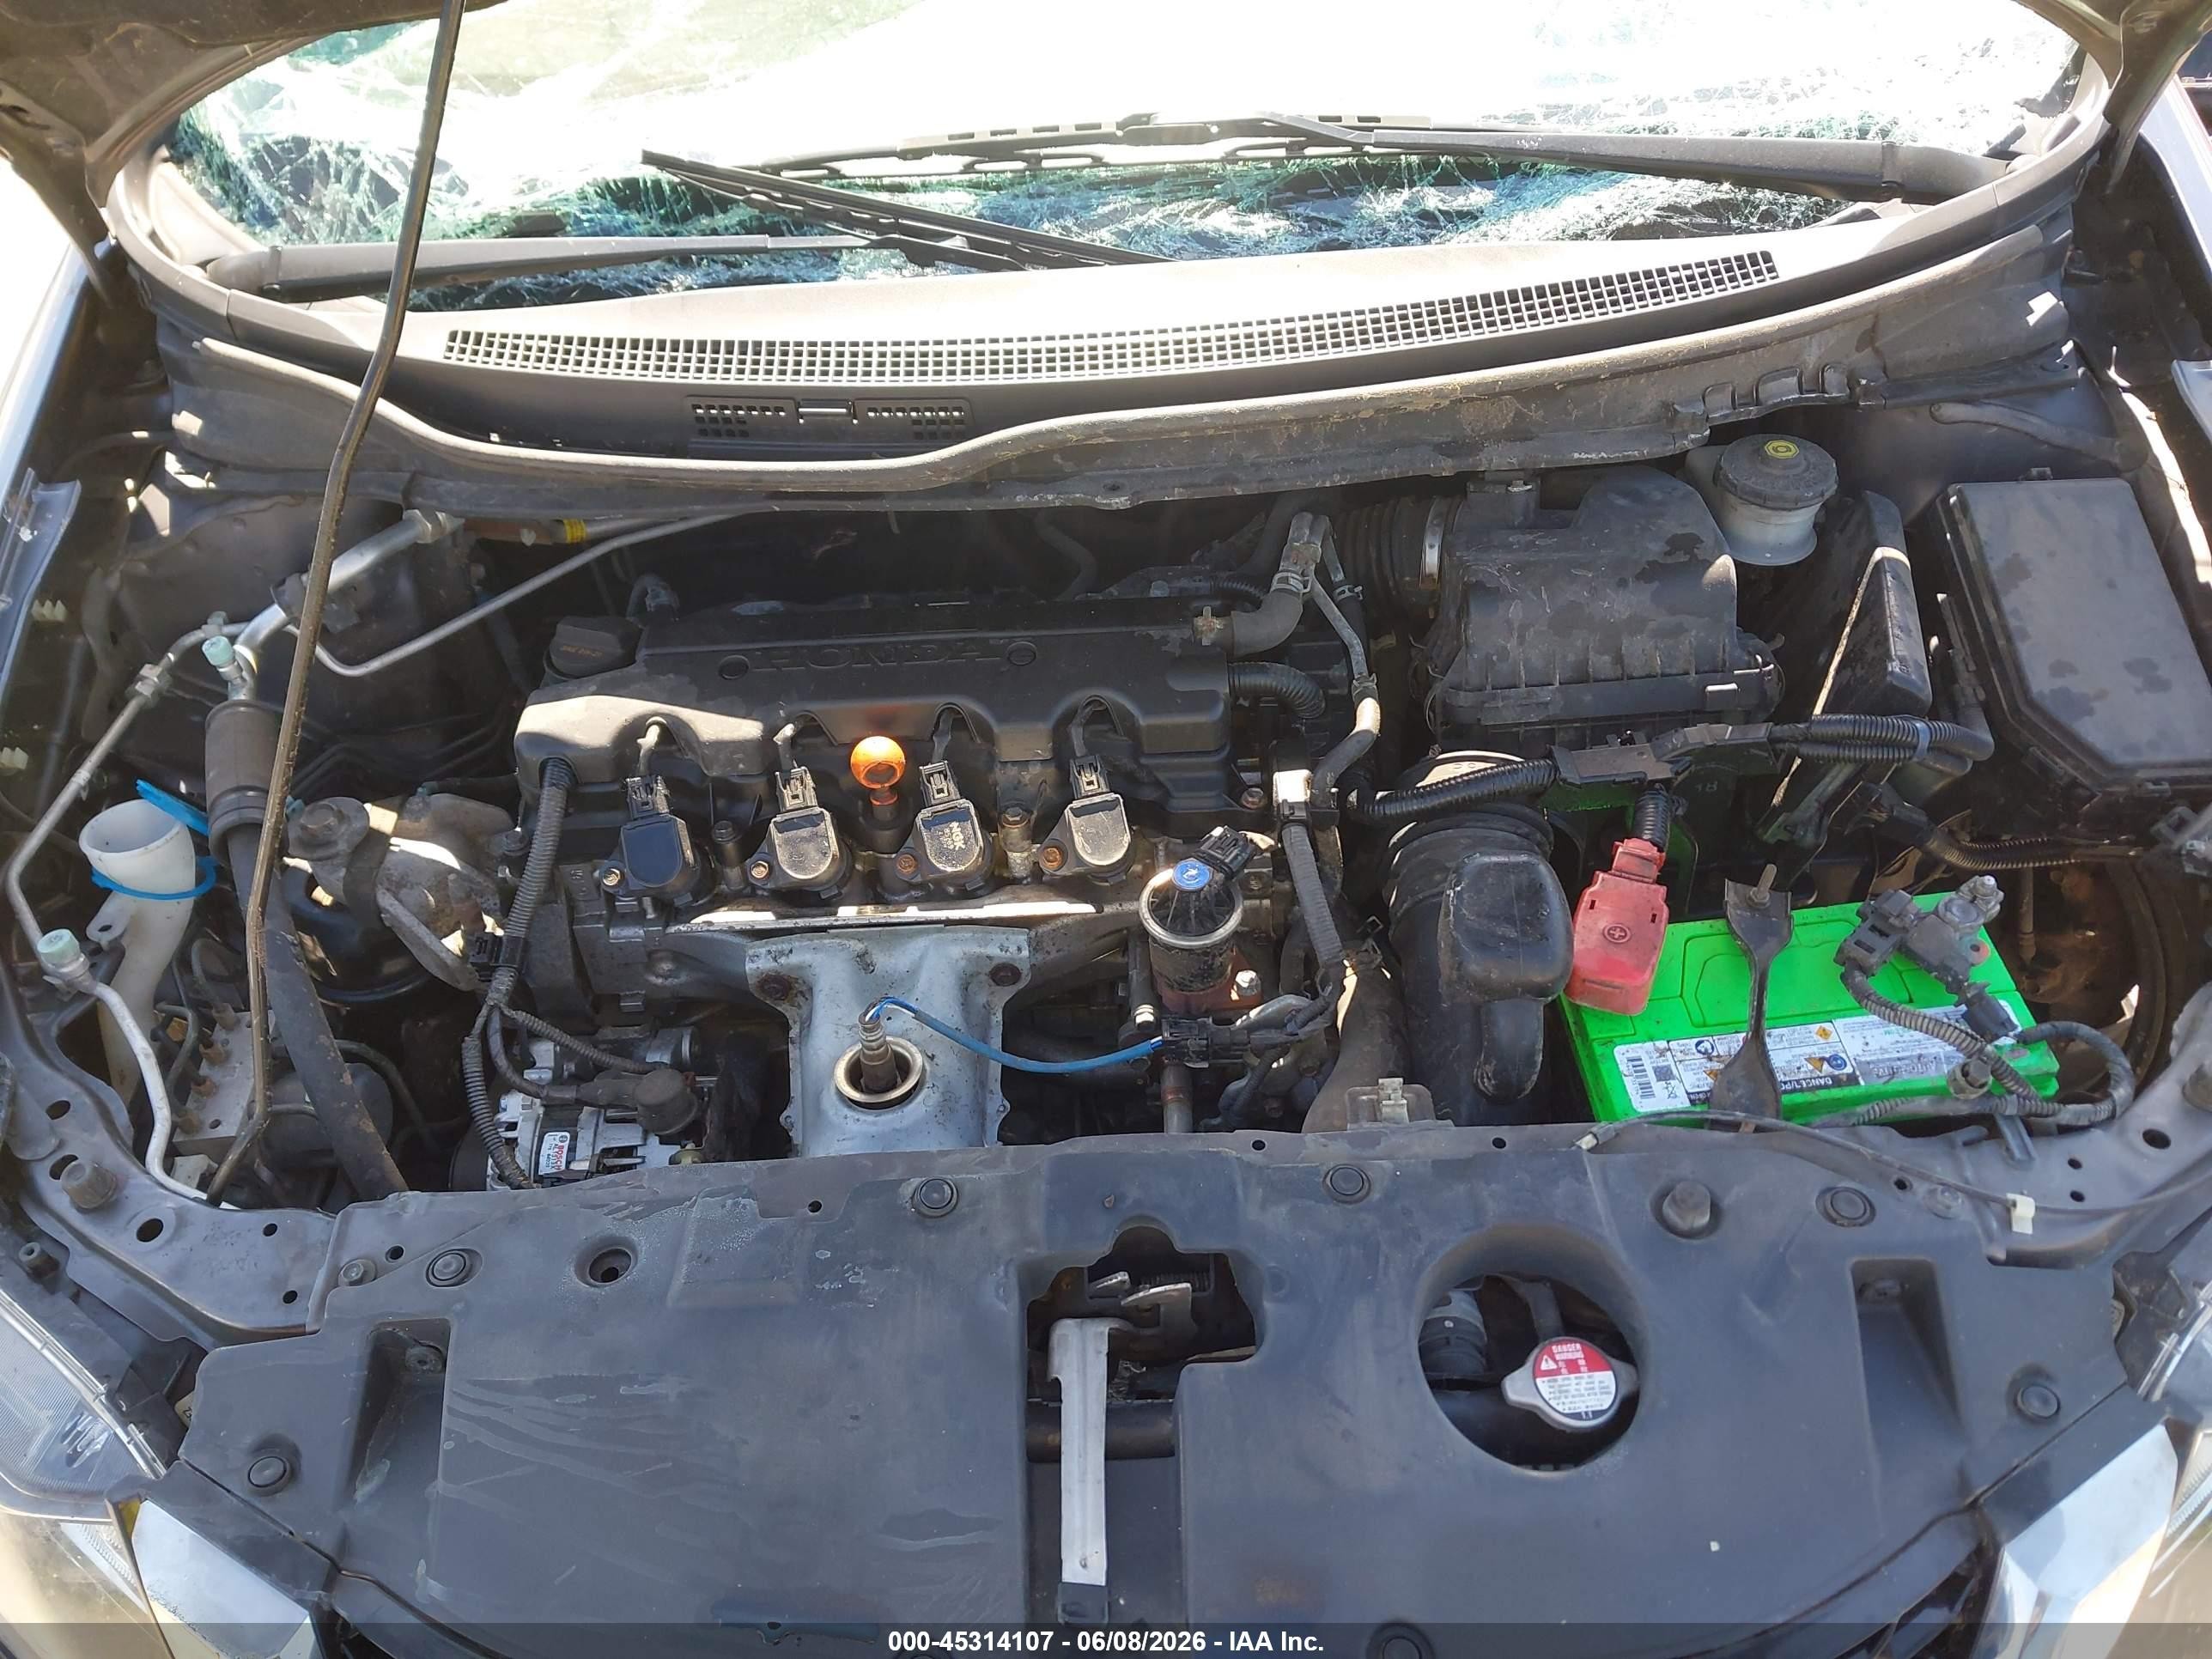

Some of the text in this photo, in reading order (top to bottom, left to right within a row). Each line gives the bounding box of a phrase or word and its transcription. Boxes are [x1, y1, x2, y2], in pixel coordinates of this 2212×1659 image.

[752, 644, 1001, 672] HONDA
[949, 821, 966, 851] NGK
[554, 1145, 564, 1170] BOSCH
